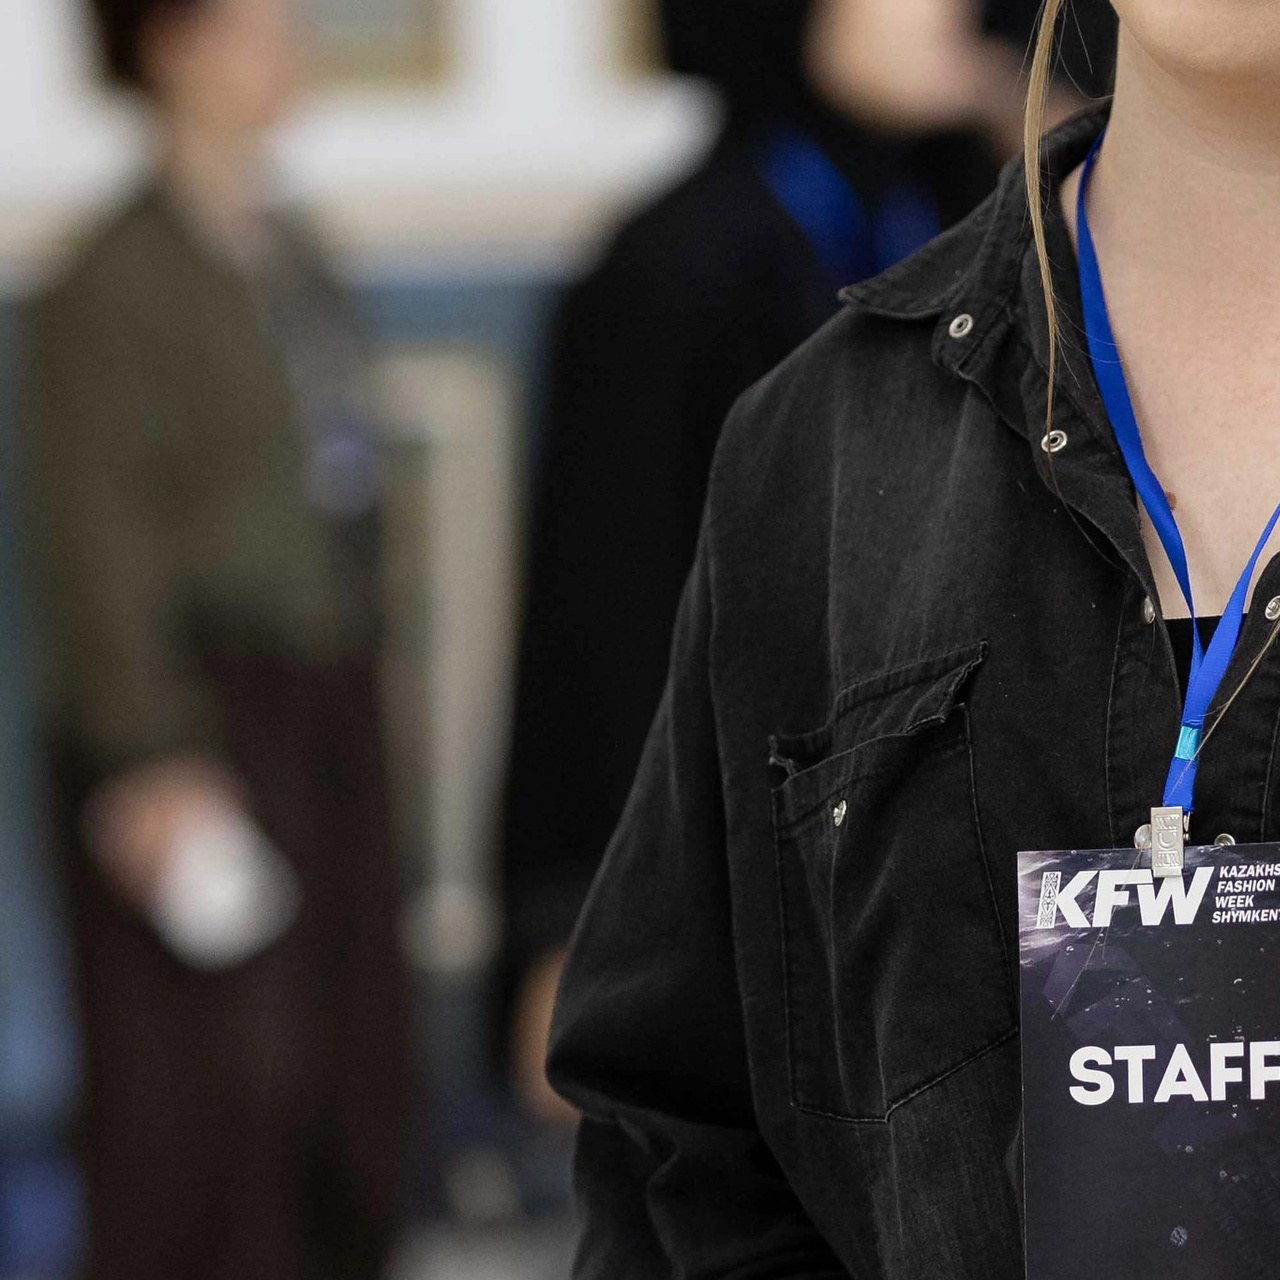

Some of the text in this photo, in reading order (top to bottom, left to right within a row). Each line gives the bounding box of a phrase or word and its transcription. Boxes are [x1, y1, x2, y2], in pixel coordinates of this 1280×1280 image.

[1216, 879, 1276, 894] FASHION
[1036, 866, 1215, 929] KFW
[1215, 895, 1255, 909] WEEK
